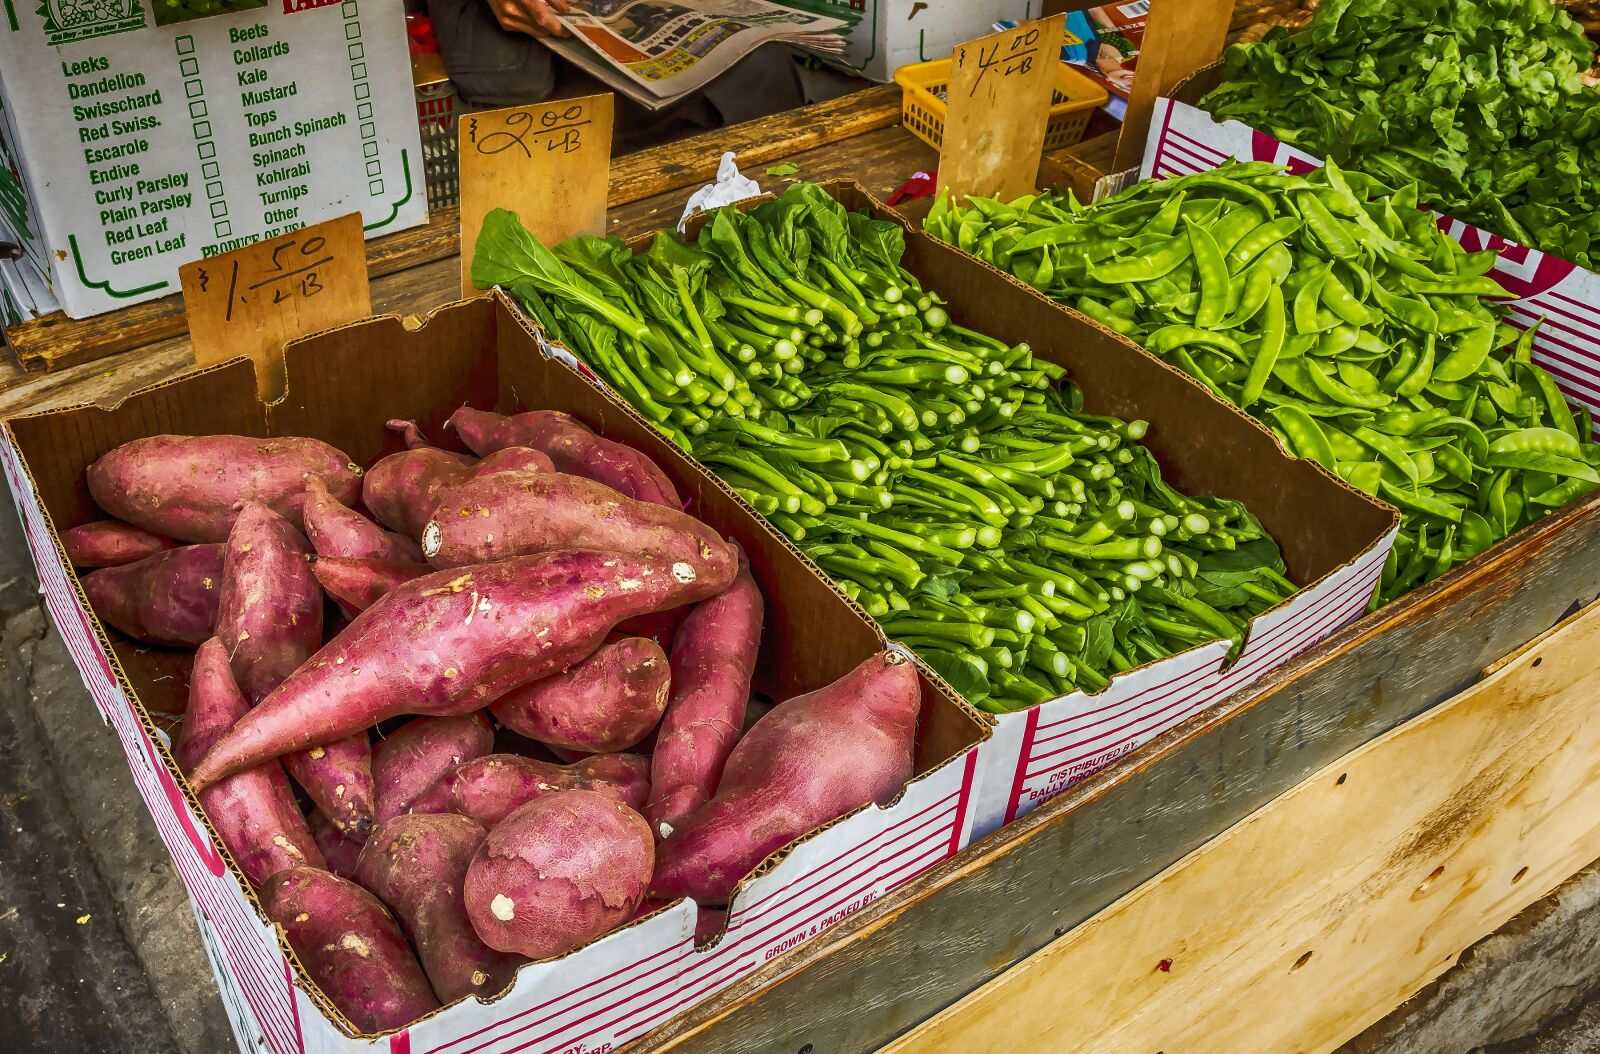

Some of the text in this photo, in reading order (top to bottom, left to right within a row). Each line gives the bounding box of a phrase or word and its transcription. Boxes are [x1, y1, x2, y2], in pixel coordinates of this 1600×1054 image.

[228, 23, 269, 44] Beets
[233, 40, 290, 65] Collards
[61, 56, 110, 77] Leeks
[237, 68, 268, 87] Kale
[67, 72, 146, 100] Dandelion
[241, 81, 298, 107] Mustard
[73, 89, 162, 121] Swisschard
[79, 116, 162, 143] Red Swiss.
[244, 110, 278, 128] Tops
[248, 112, 347, 148] Bunch Spinach
[84, 139, 149, 165] Escarole
[252, 143, 306, 168] Spinach
[90, 163, 140, 185] Endive
[256, 161, 311, 187] Kohlrabi
[95, 172, 189, 205] Curly Parsley
[259, 184, 309, 206] Turnips
[100, 192, 192, 226] Plain Parsley
[264, 207, 299, 225] Other
[105, 217, 168, 246] Red Leaf
[111, 232, 186, 265] Green Leaf
[1049, 749, 1121, 784] DISTRIBUTED
[1029, 780, 1067, 801] BALLY
[764, 889, 878, 961] GROWN & PACKED BY:
